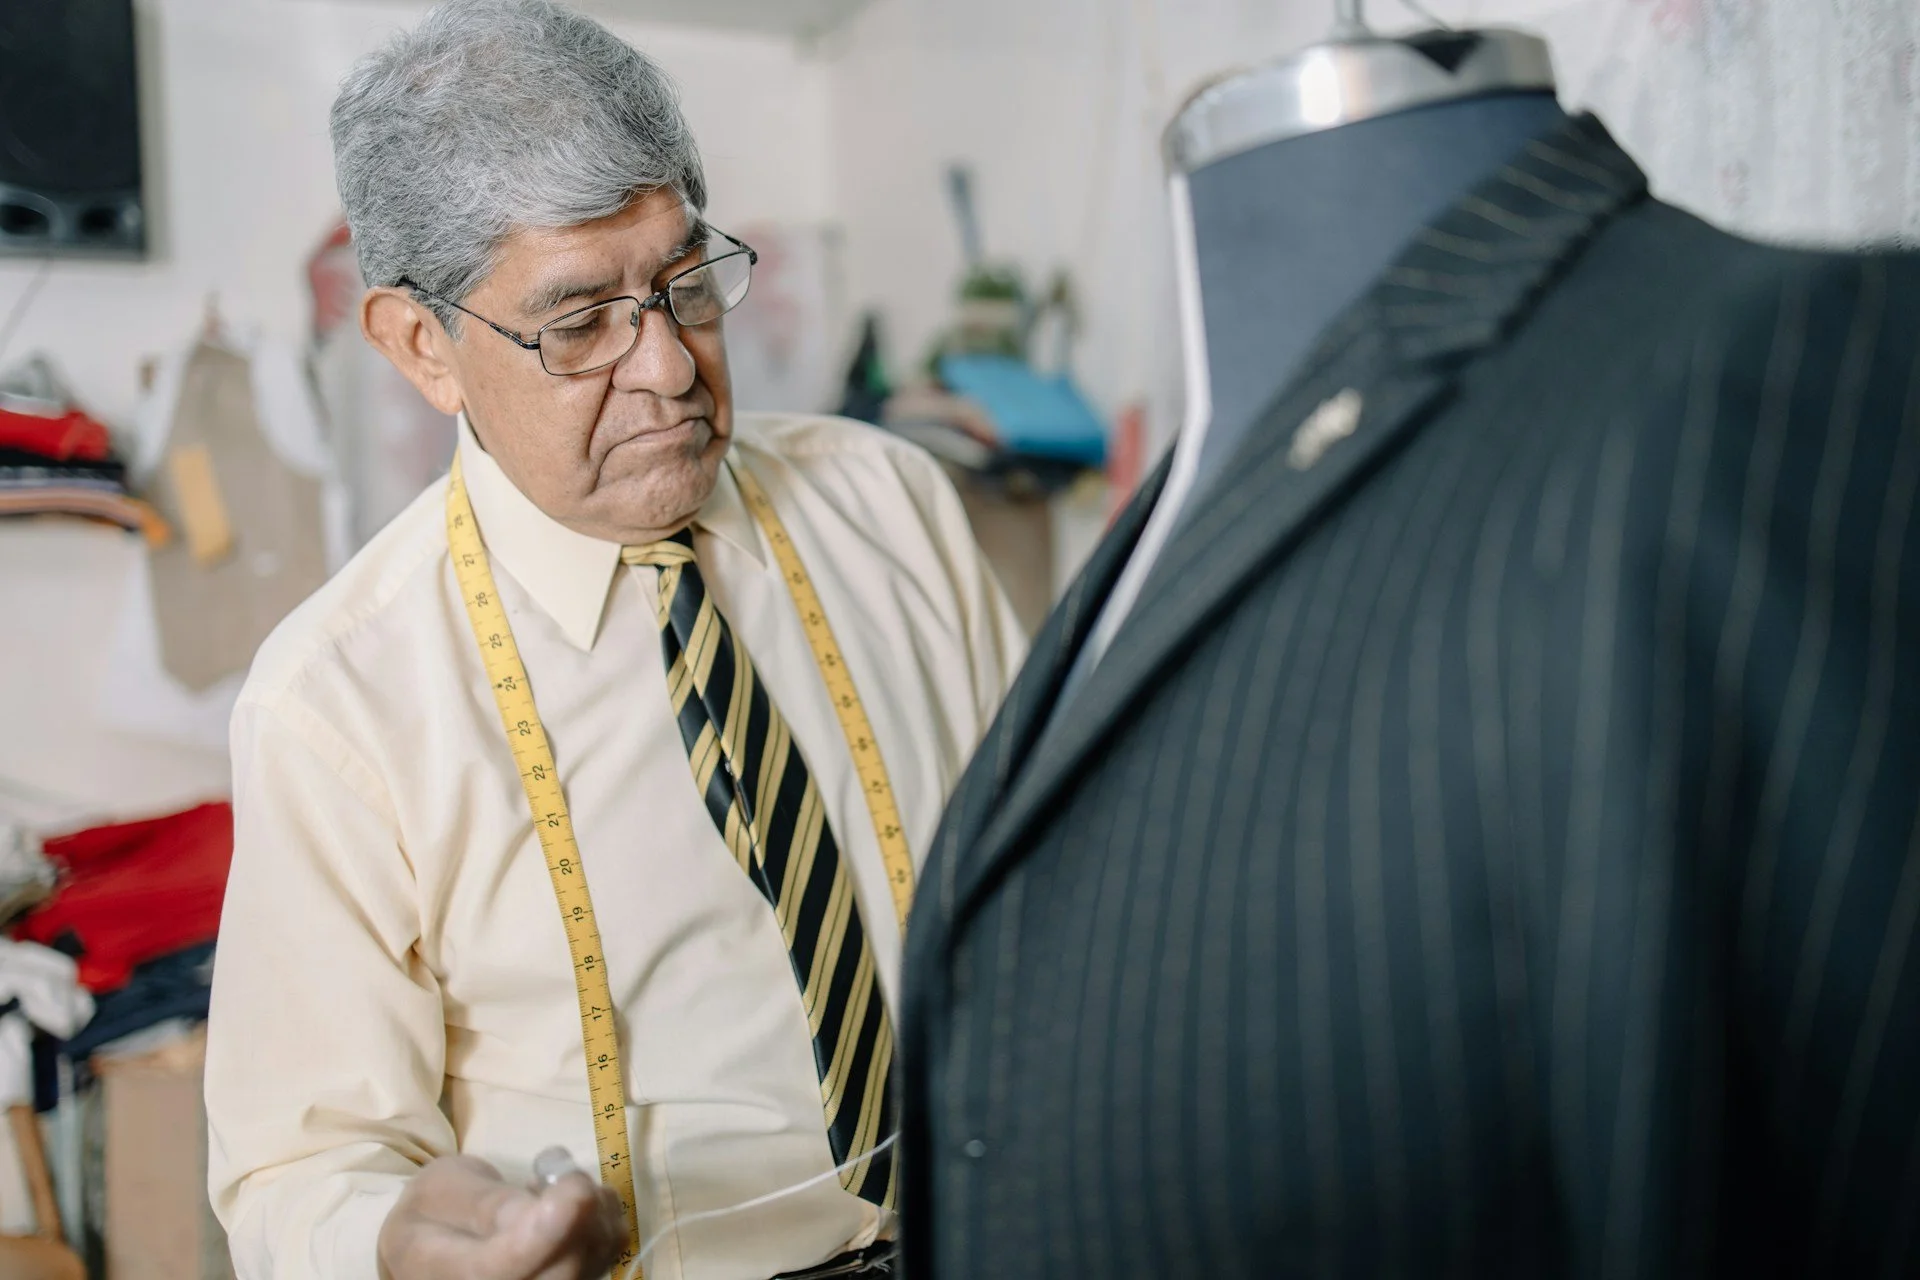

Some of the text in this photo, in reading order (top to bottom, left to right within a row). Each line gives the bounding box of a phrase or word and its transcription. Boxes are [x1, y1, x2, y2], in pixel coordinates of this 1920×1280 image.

[462, 553, 475, 567] 27
[475, 592, 488, 608] 26
[489, 633, 502, 649] 25
[503, 676, 517, 691] 24
[517, 720, 531, 736] 23
[532, 764, 546, 781] 22
[546, 812, 559, 828] 21
[559, 858, 572, 875] 20
[572, 906, 584, 922] 19
[584, 955, 595, 972] 18
[591, 1006, 602, 1021] 17
[598, 1054, 609, 1071] 16
[604, 1103, 615, 1120] 15
[610, 1152, 621, 1169] 14
[620, 1249, 632, 1267] 12
